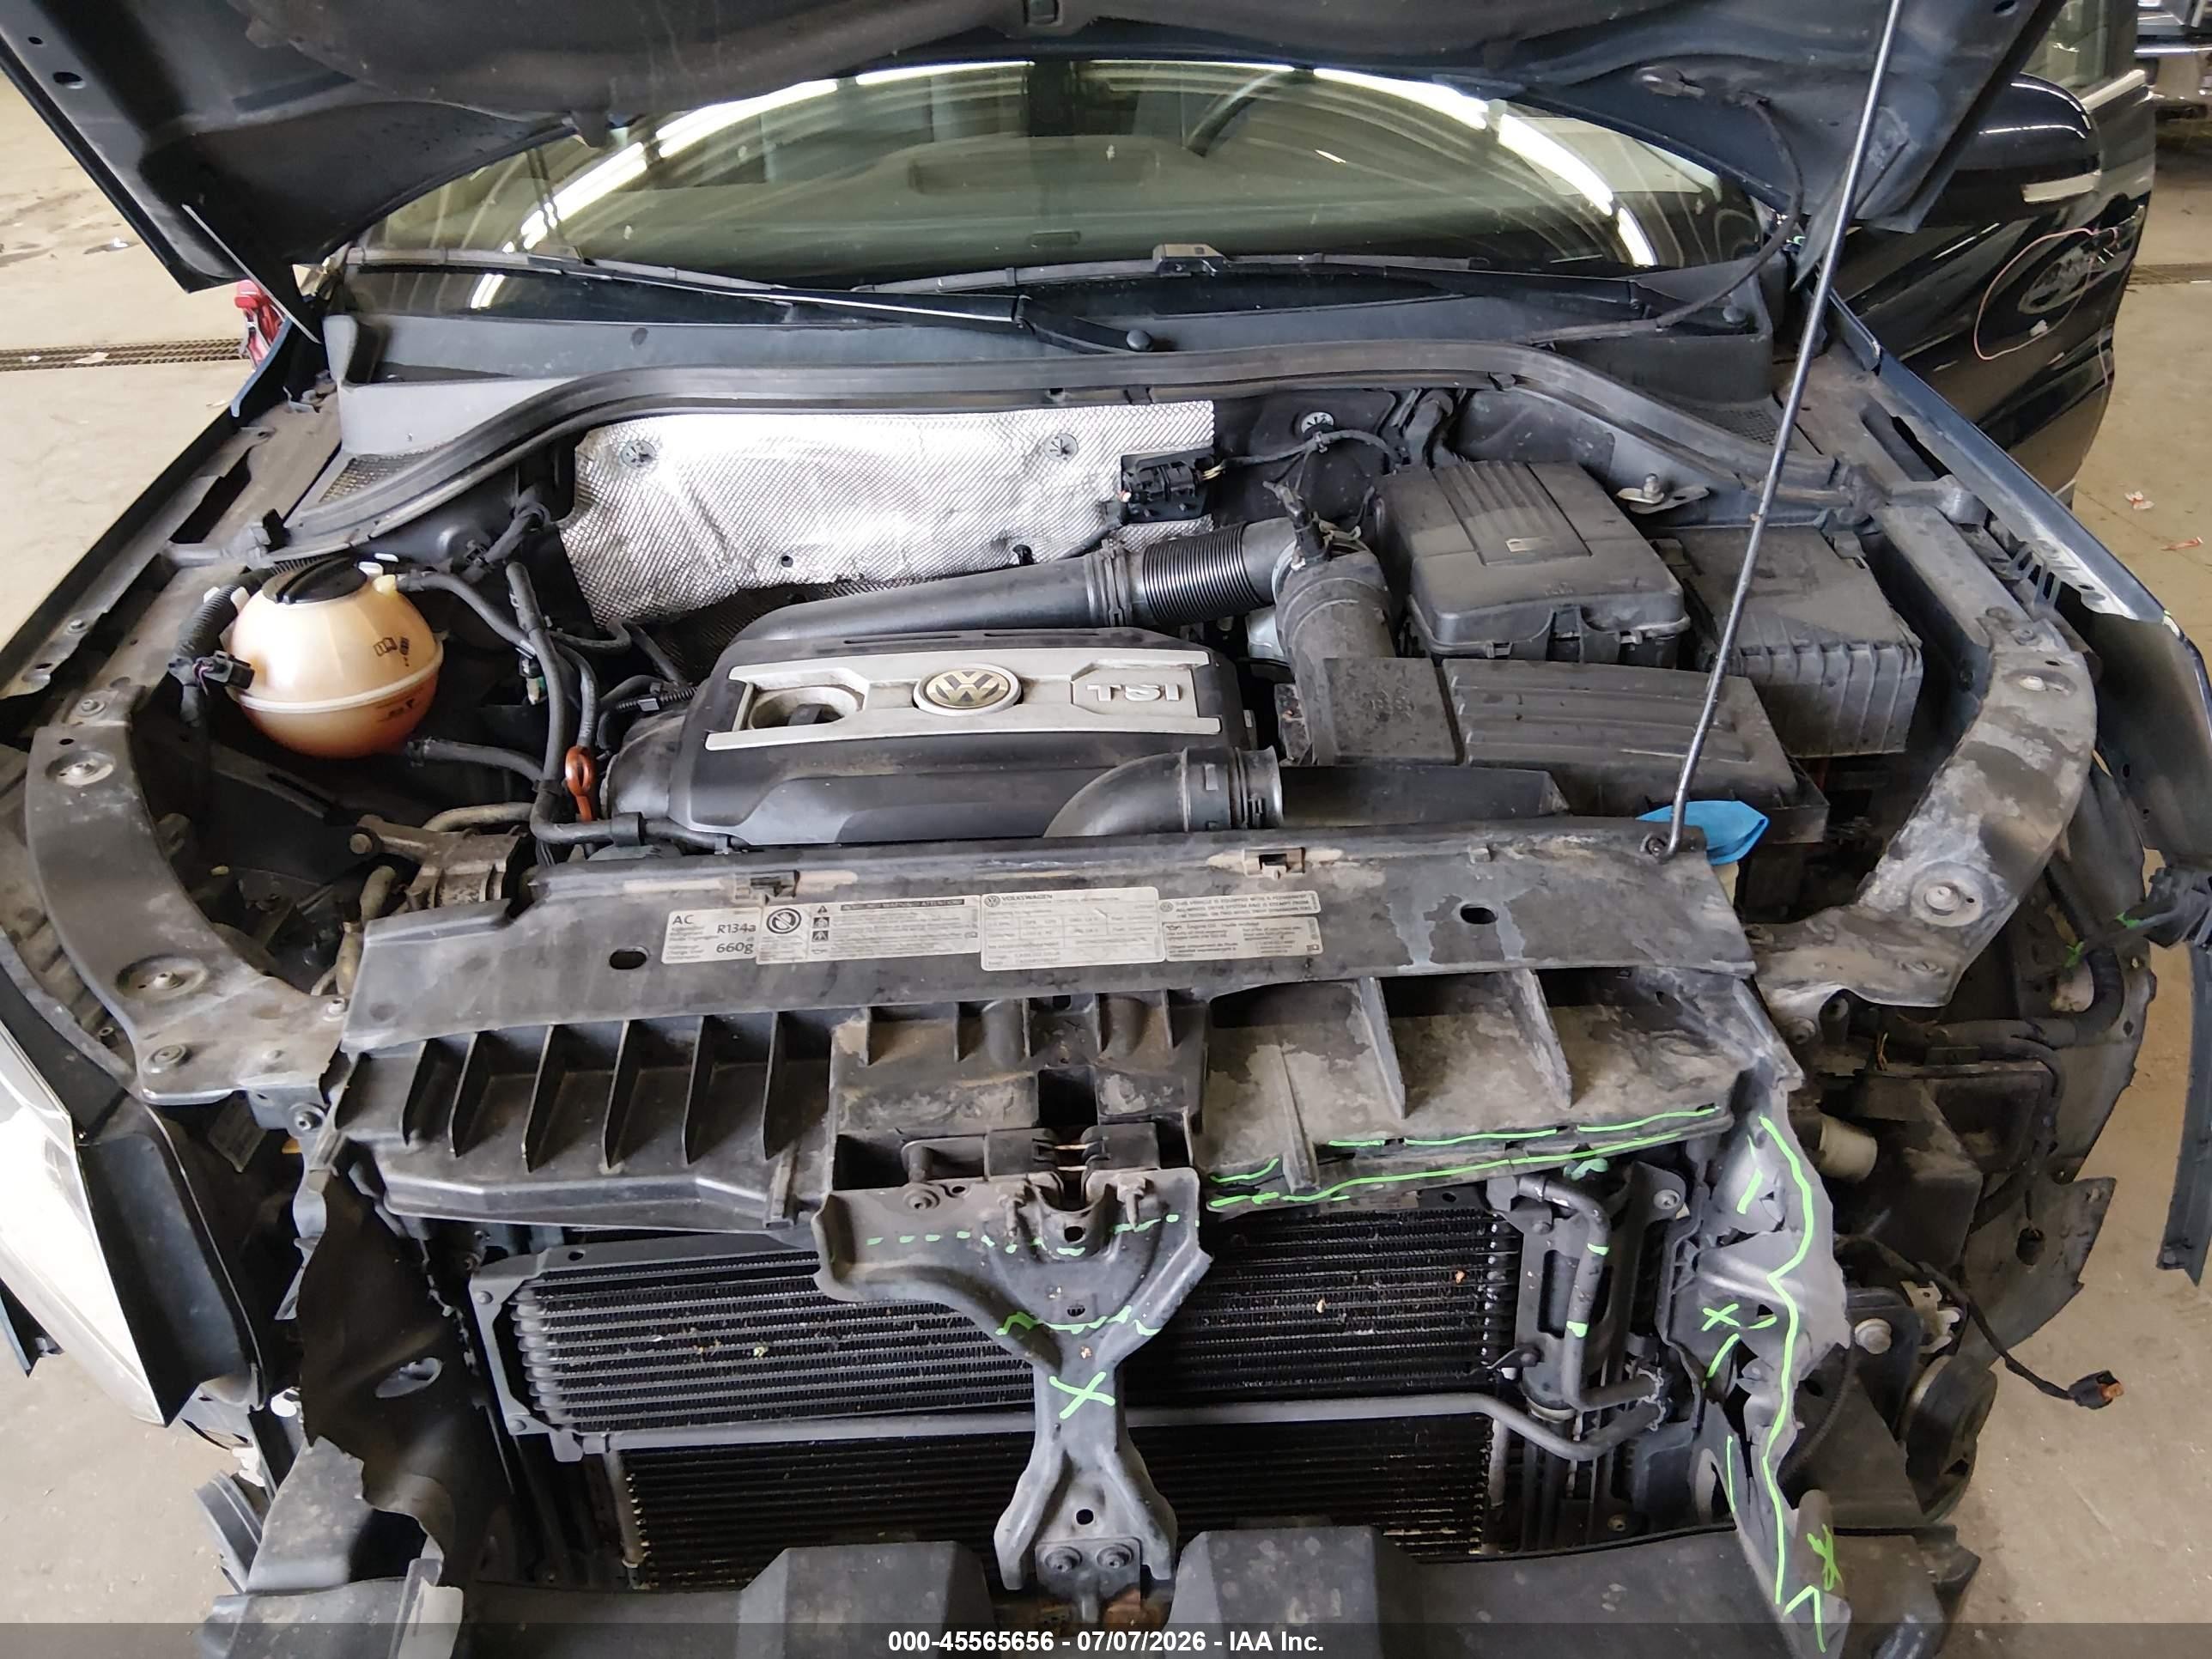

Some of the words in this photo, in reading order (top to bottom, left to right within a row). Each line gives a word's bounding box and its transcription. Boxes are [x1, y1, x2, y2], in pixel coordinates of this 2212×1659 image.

[1085, 684, 1181, 702] TSI
[672, 915, 694, 925] AC
[717, 923, 757, 933] R134a
[716, 942, 753, 954] 660g
